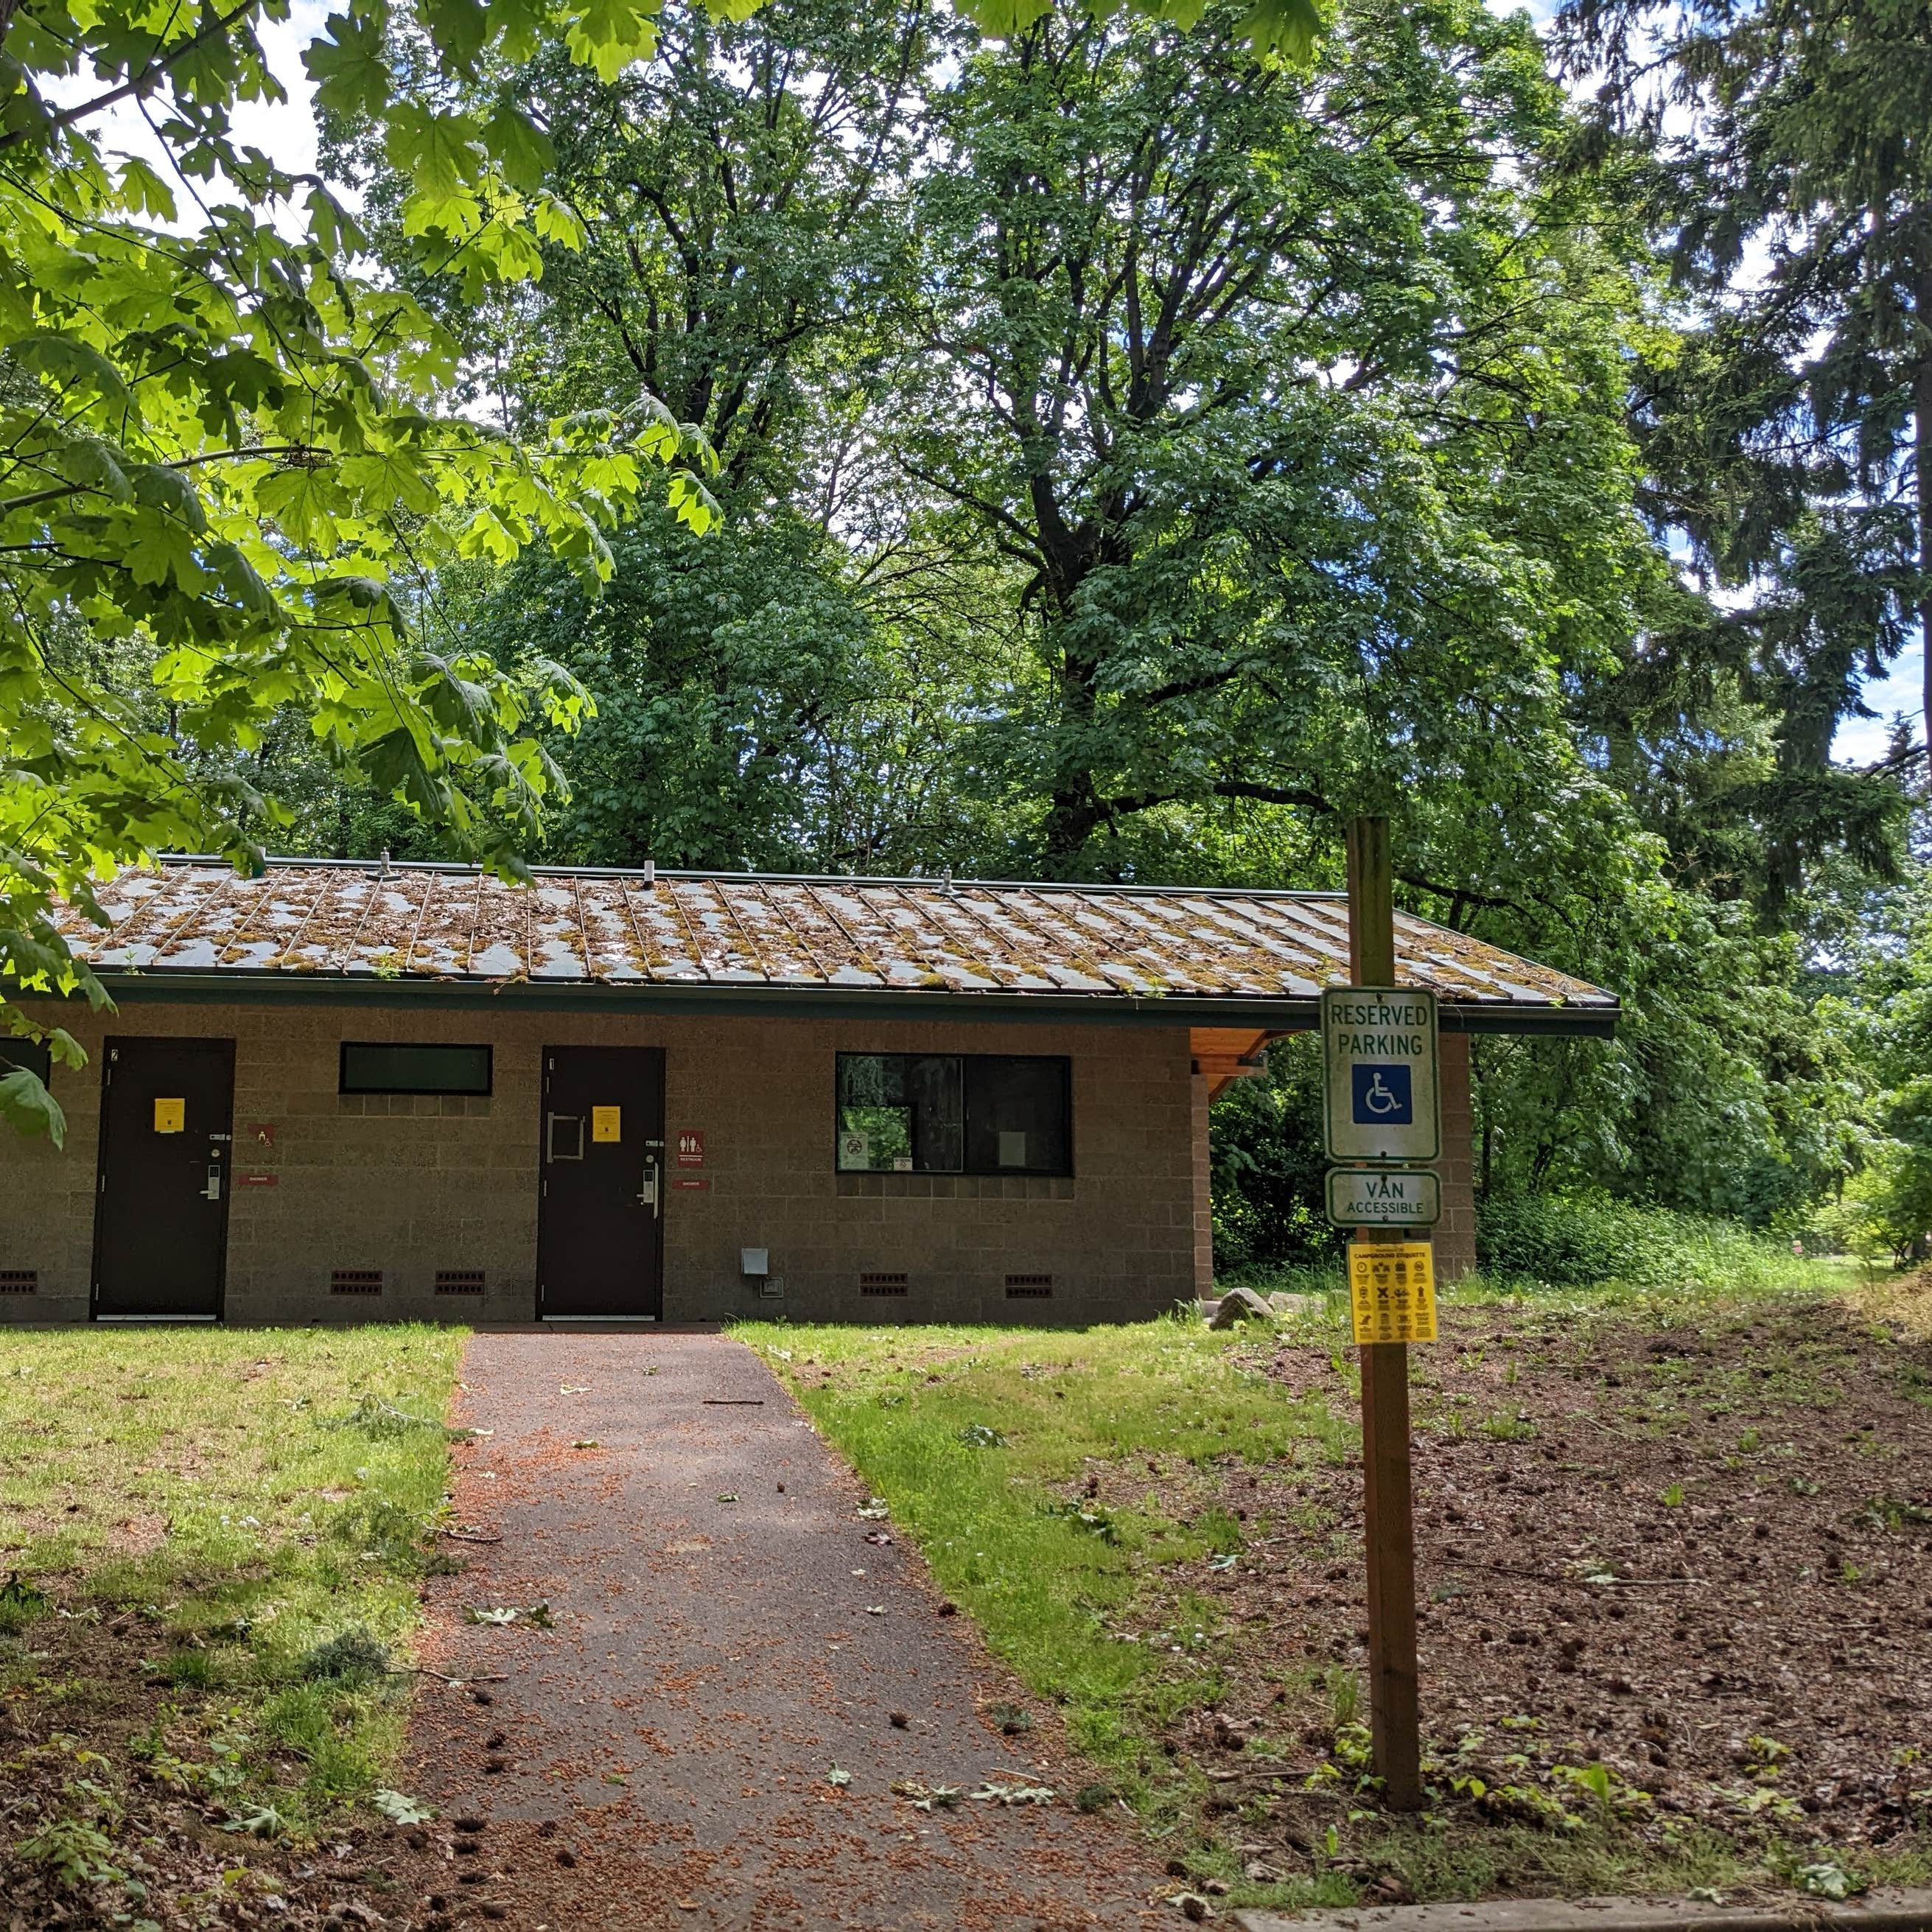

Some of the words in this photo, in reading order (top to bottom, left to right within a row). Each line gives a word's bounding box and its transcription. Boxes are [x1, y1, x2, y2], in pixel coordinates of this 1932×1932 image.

[1331, 1005, 1427, 1026] RESERVED
[1338, 1034, 1423, 1055] PARKING
[1365, 1182, 1404, 1198] VAN
[1347, 1203, 1424, 1214] ACCESSIBLE
